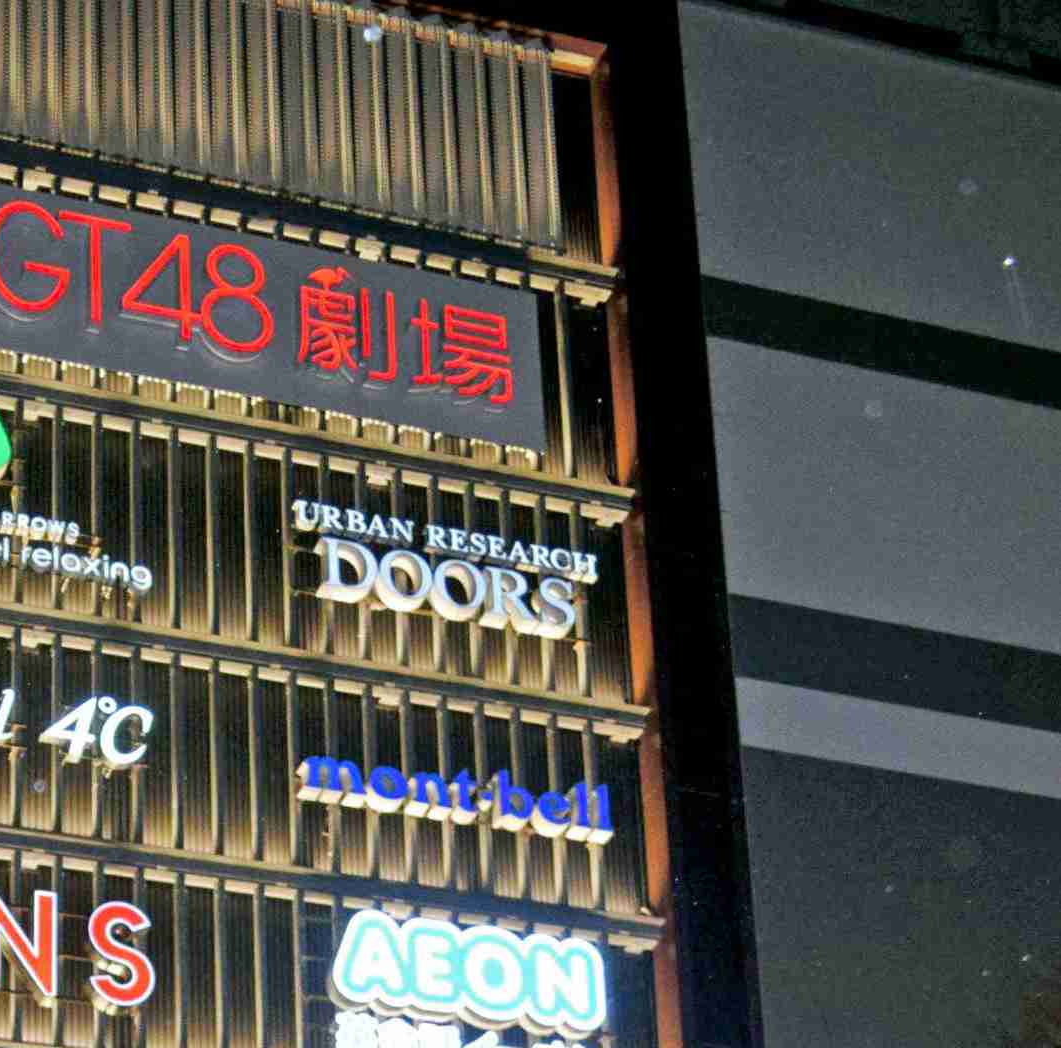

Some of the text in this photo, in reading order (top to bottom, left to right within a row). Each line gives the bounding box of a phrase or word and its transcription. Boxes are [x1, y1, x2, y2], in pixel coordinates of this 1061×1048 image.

[297, 265, 515, 405] 劇場
[20, 539, 153, 592] relaxing
[294, 499, 599, 578] URBAN RESEARCH
[316, 536, 577, 636] DOORS
[338, 915, 603, 1027] AEON
